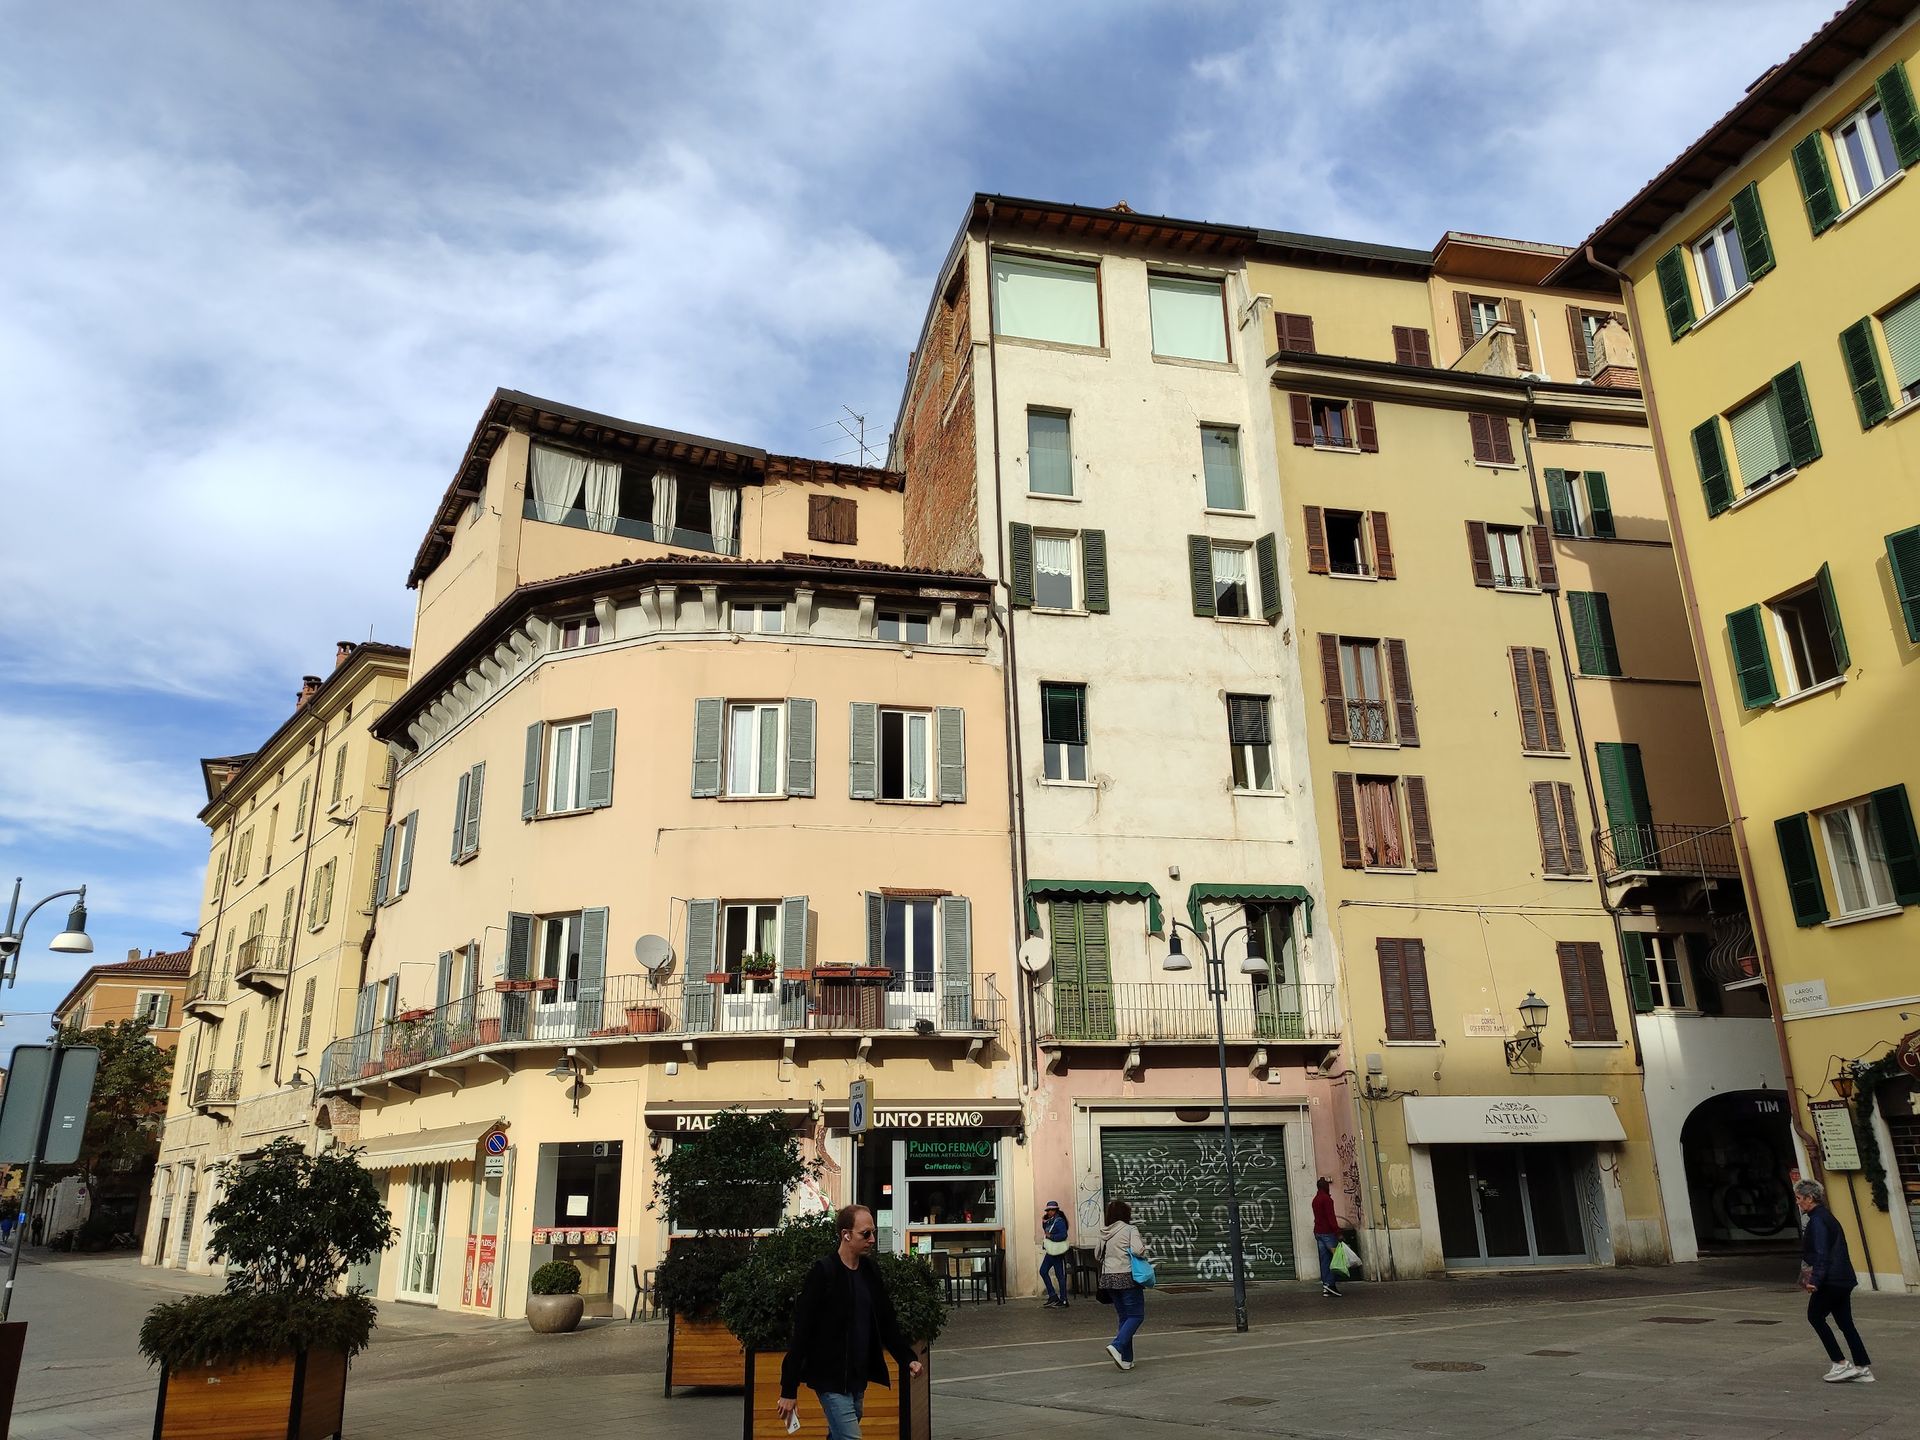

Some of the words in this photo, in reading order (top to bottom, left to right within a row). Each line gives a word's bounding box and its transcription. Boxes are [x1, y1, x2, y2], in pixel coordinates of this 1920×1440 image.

[1794, 987, 1814, 996] LARGO
[1754, 1100, 1780, 1113] TIM
[873, 1112, 922, 1127] UNTO
[924, 1162, 962, 1171] Caffetteria
